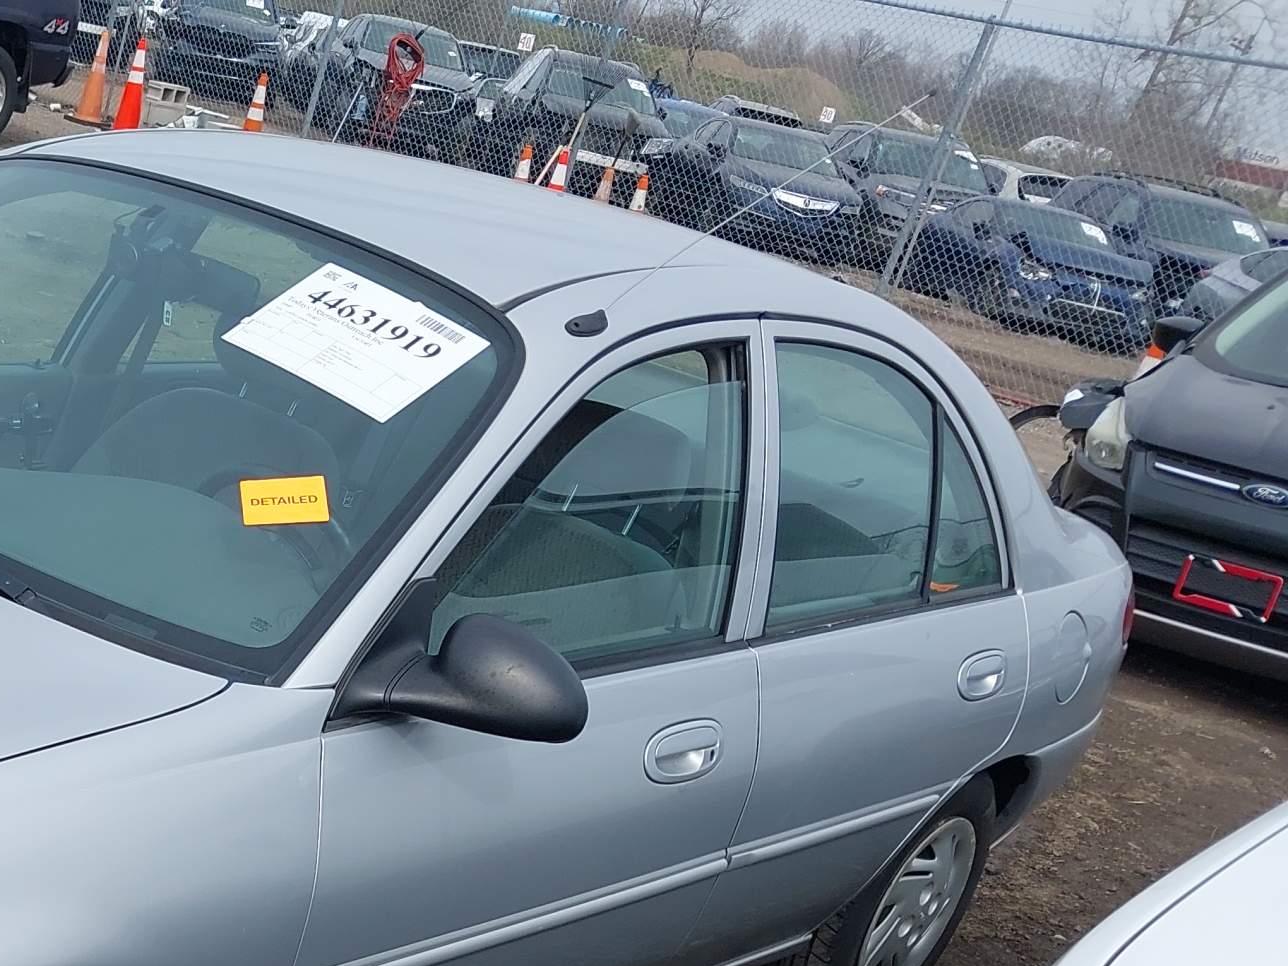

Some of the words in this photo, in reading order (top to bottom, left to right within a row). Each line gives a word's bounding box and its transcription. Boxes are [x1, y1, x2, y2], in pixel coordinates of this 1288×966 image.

[307, 290, 442, 359] 44631919
[250, 494, 318, 506] DETAILED
[1252, 487, 1286, 504] Ford
